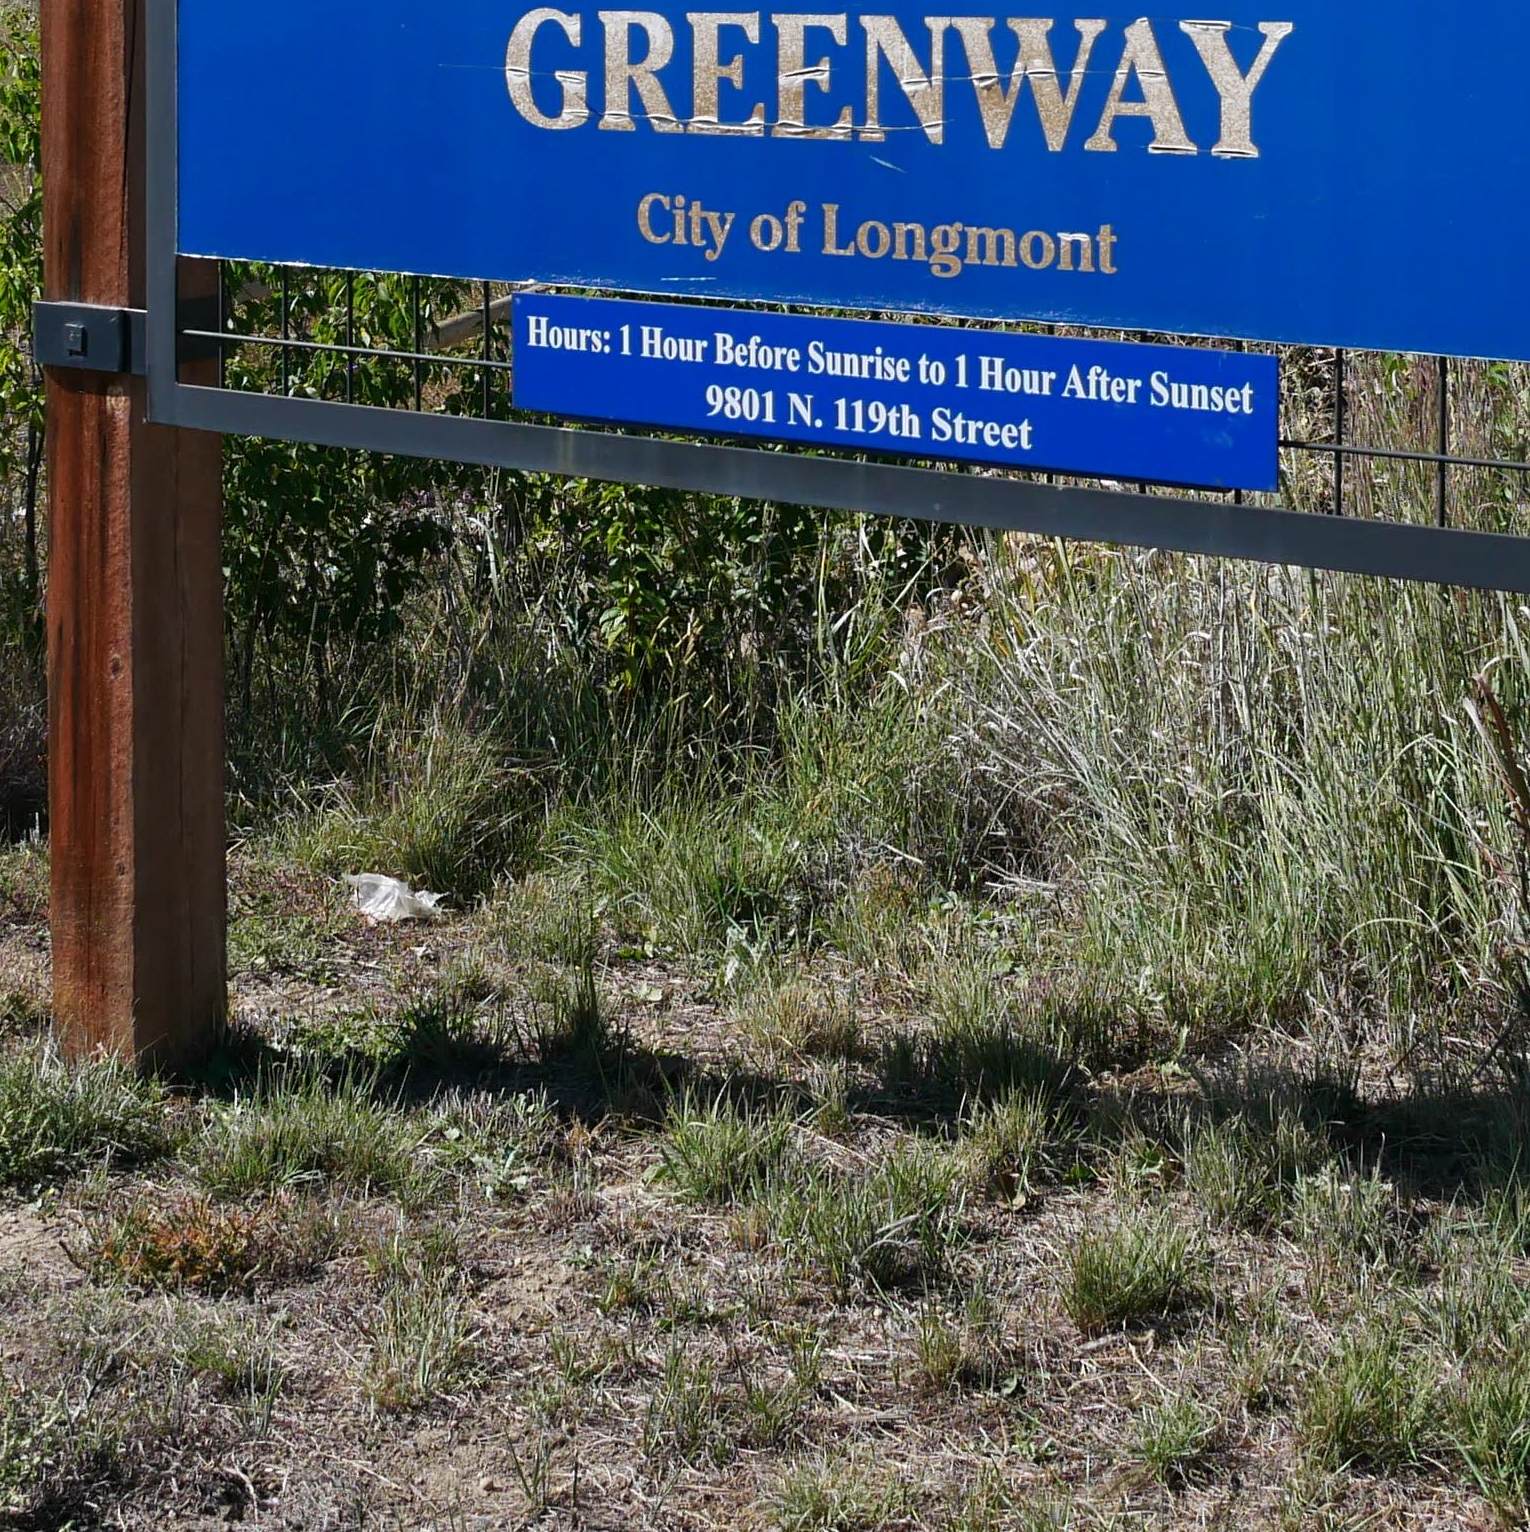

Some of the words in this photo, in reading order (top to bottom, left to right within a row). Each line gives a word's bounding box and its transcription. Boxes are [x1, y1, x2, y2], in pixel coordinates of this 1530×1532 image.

[504, 8, 1293, 159] GREENWAY
[638, 193, 735, 261] City
[750, 201, 806, 252] of
[822, 204, 1117, 277] Longmont
[528, 316, 610, 353] Hours:
[620, 325, 631, 355] 1
[641, 326, 708, 362] Hour
[714, 333, 800, 372] Before
[808, 341, 910, 382] Sunrise
[918, 354, 945, 385] to
[956, 355, 968, 387] 1
[979, 356, 1056, 395] Hour
[1062, 364, 1141, 403] After
[1151, 371, 1253, 414] Sunset
[706, 385, 775, 422] 9801
[788, 393, 822, 428] N.
[835, 398, 920, 438] 119th
[932, 408, 1032, 449] Street
